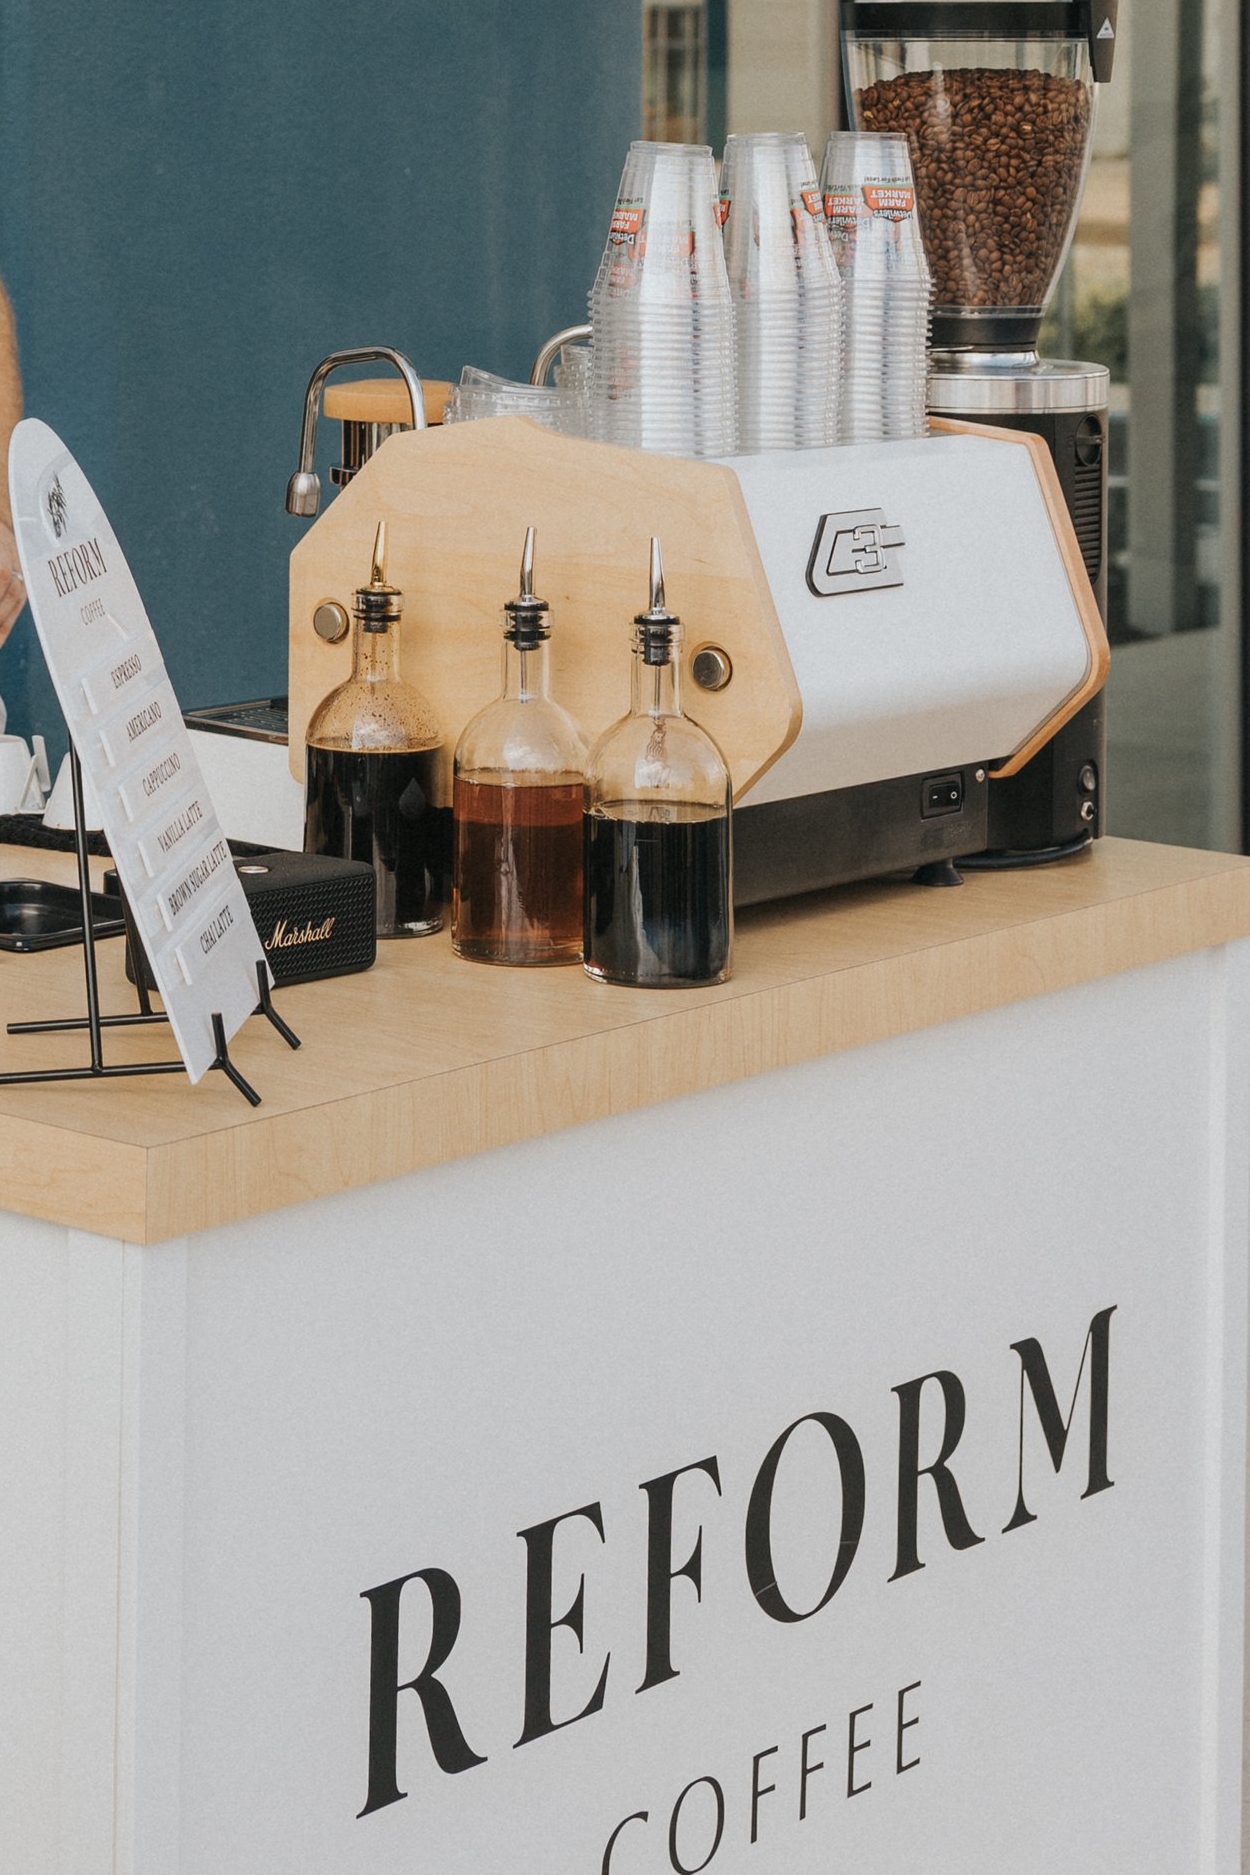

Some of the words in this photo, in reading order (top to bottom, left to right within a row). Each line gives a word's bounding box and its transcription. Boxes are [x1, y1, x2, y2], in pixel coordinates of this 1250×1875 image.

[828, 197, 863, 206] ARKET
[870, 189, 911, 199] MARKET
[878, 198, 907, 207] FARM
[47, 538, 107, 597] REFORM
[80, 598, 106, 625] COFFEE
[110, 653, 142, 689] ESPRESSO
[125, 701, 162, 743] AMERICANO
[142, 752, 181, 797] CAPPUCCINO
[157, 817, 186, 853] VANILLA
[182, 800, 203, 831] LATTE
[168, 878, 193, 916] BROWN
[189, 859, 210, 892] SUGAR
[206, 841, 227, 872] LATTE
[199, 921, 217, 954] CHAI
[213, 905, 234, 938] LATTE
[264, 916, 335, 950] Marshall
[355, 1304, 1118, 1820] REFORM
[601, 1680, 923, 1875] COFFEE
